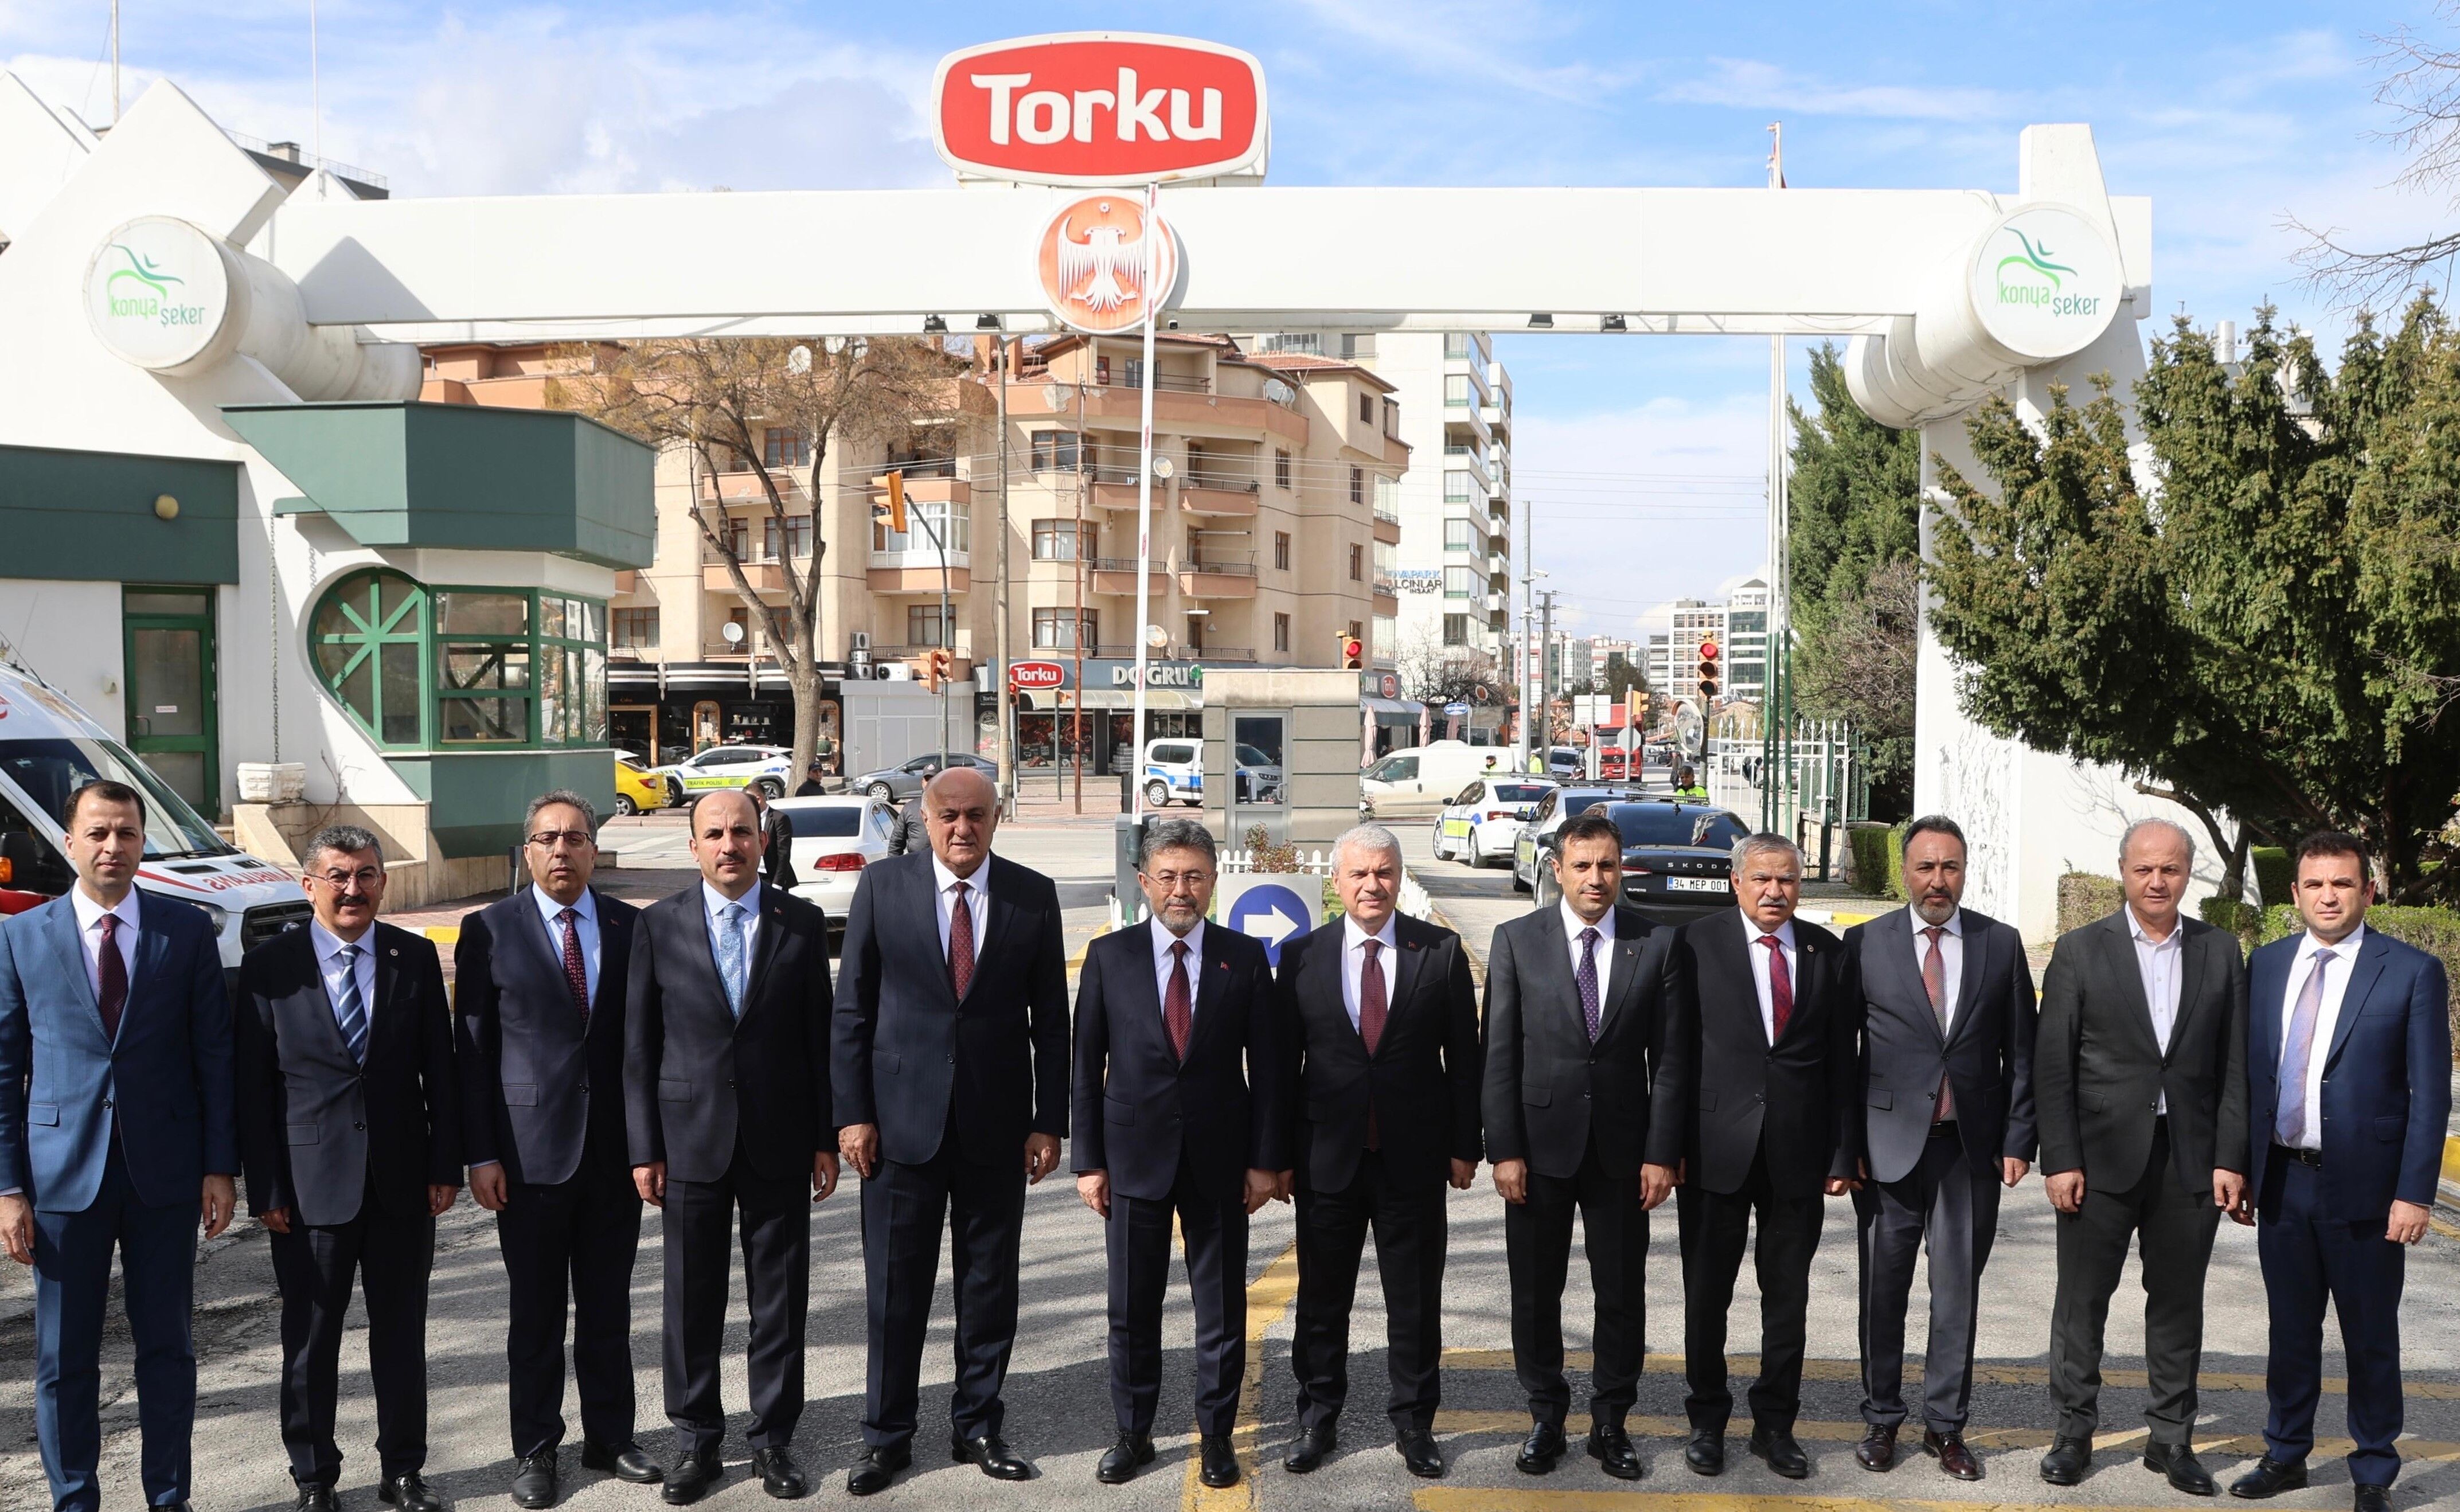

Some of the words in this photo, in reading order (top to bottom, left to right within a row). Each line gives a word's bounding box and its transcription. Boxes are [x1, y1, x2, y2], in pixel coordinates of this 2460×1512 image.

[970, 67, 1223, 146] Torku
[2000, 282, 2050, 308] konya
[2052, 293, 2100, 317] şeker
[111, 296, 157, 319] konya
[161, 304, 205, 328] şeker
[1014, 667, 1057, 681] Torku
[1365, 676, 1377, 693] DAN
[1674, 878, 1684, 889] 34
[1690, 880, 1707, 890] MEP
[1711, 881, 1727, 891] 001
